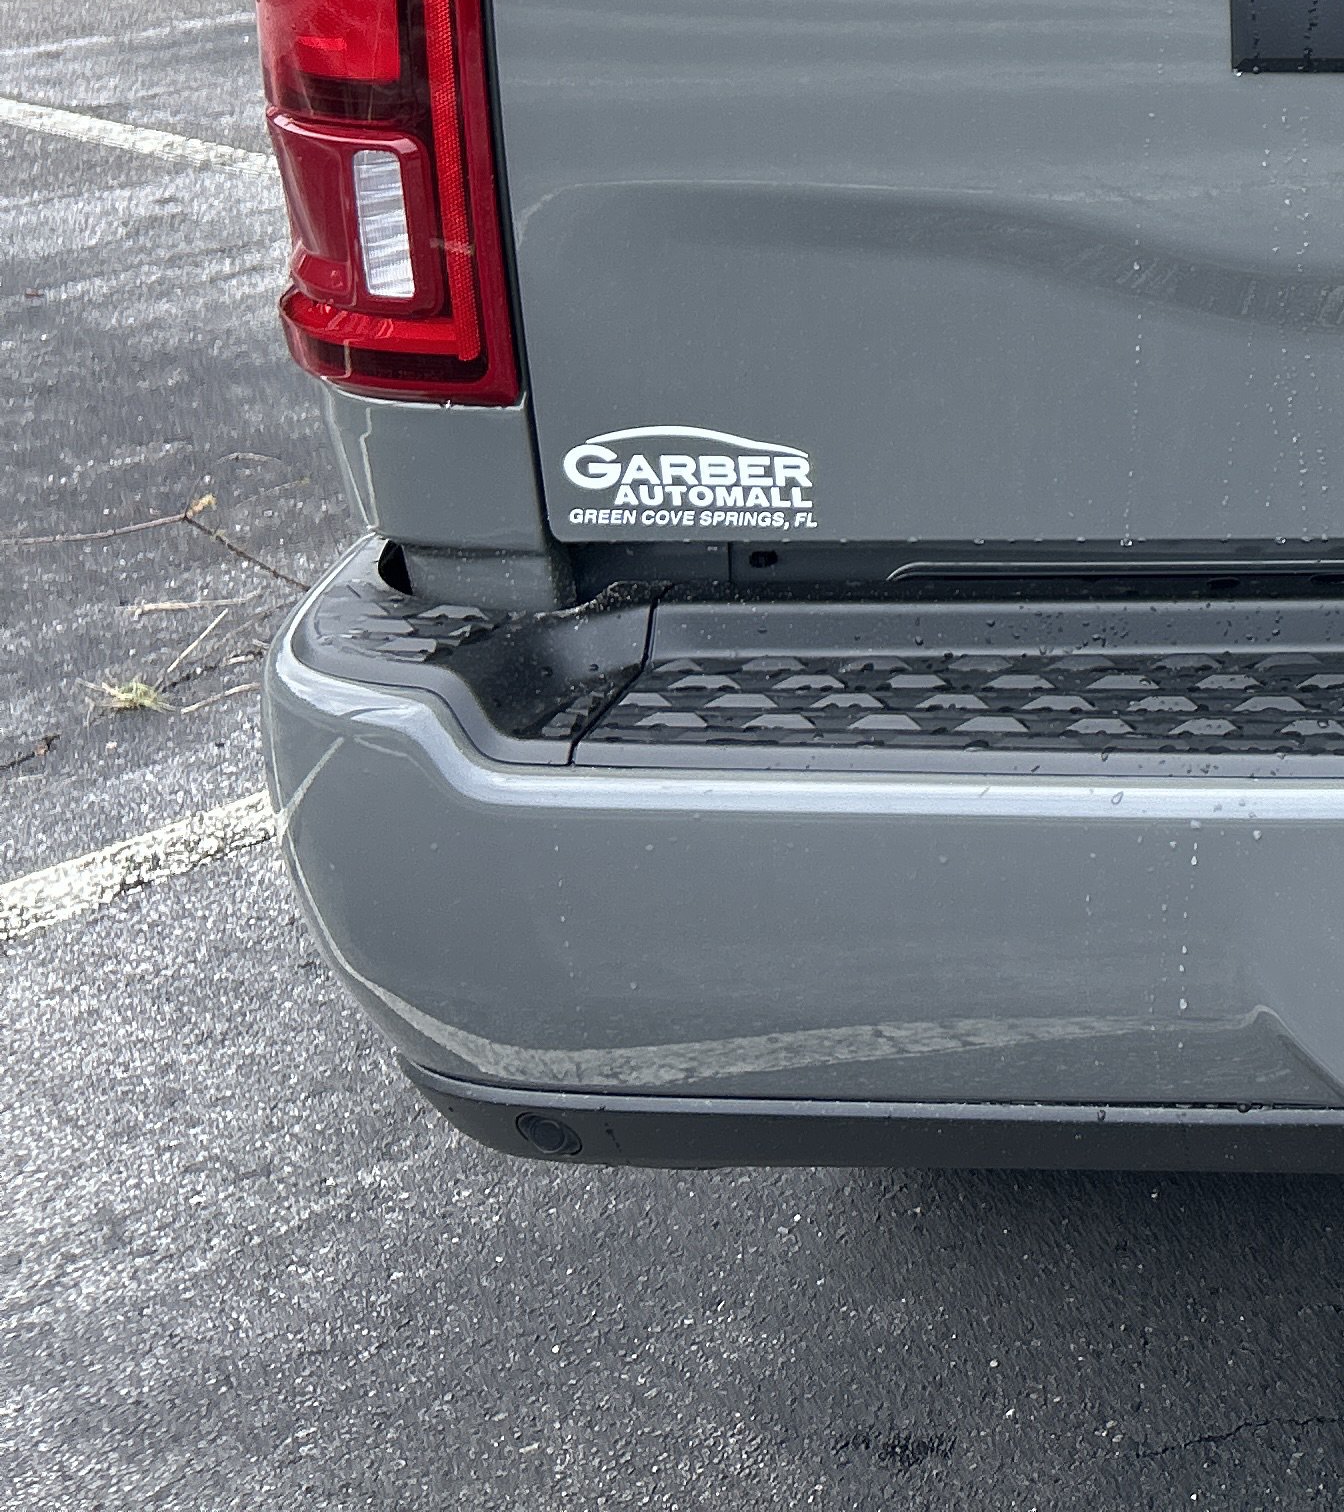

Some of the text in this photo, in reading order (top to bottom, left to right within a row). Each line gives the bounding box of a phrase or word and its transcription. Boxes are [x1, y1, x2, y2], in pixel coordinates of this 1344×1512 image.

[563, 444, 813, 489] GARBER
[613, 485, 813, 508] AUTOMALL
[569, 508, 818, 530] GREEN COVE SPRINGS, FL
